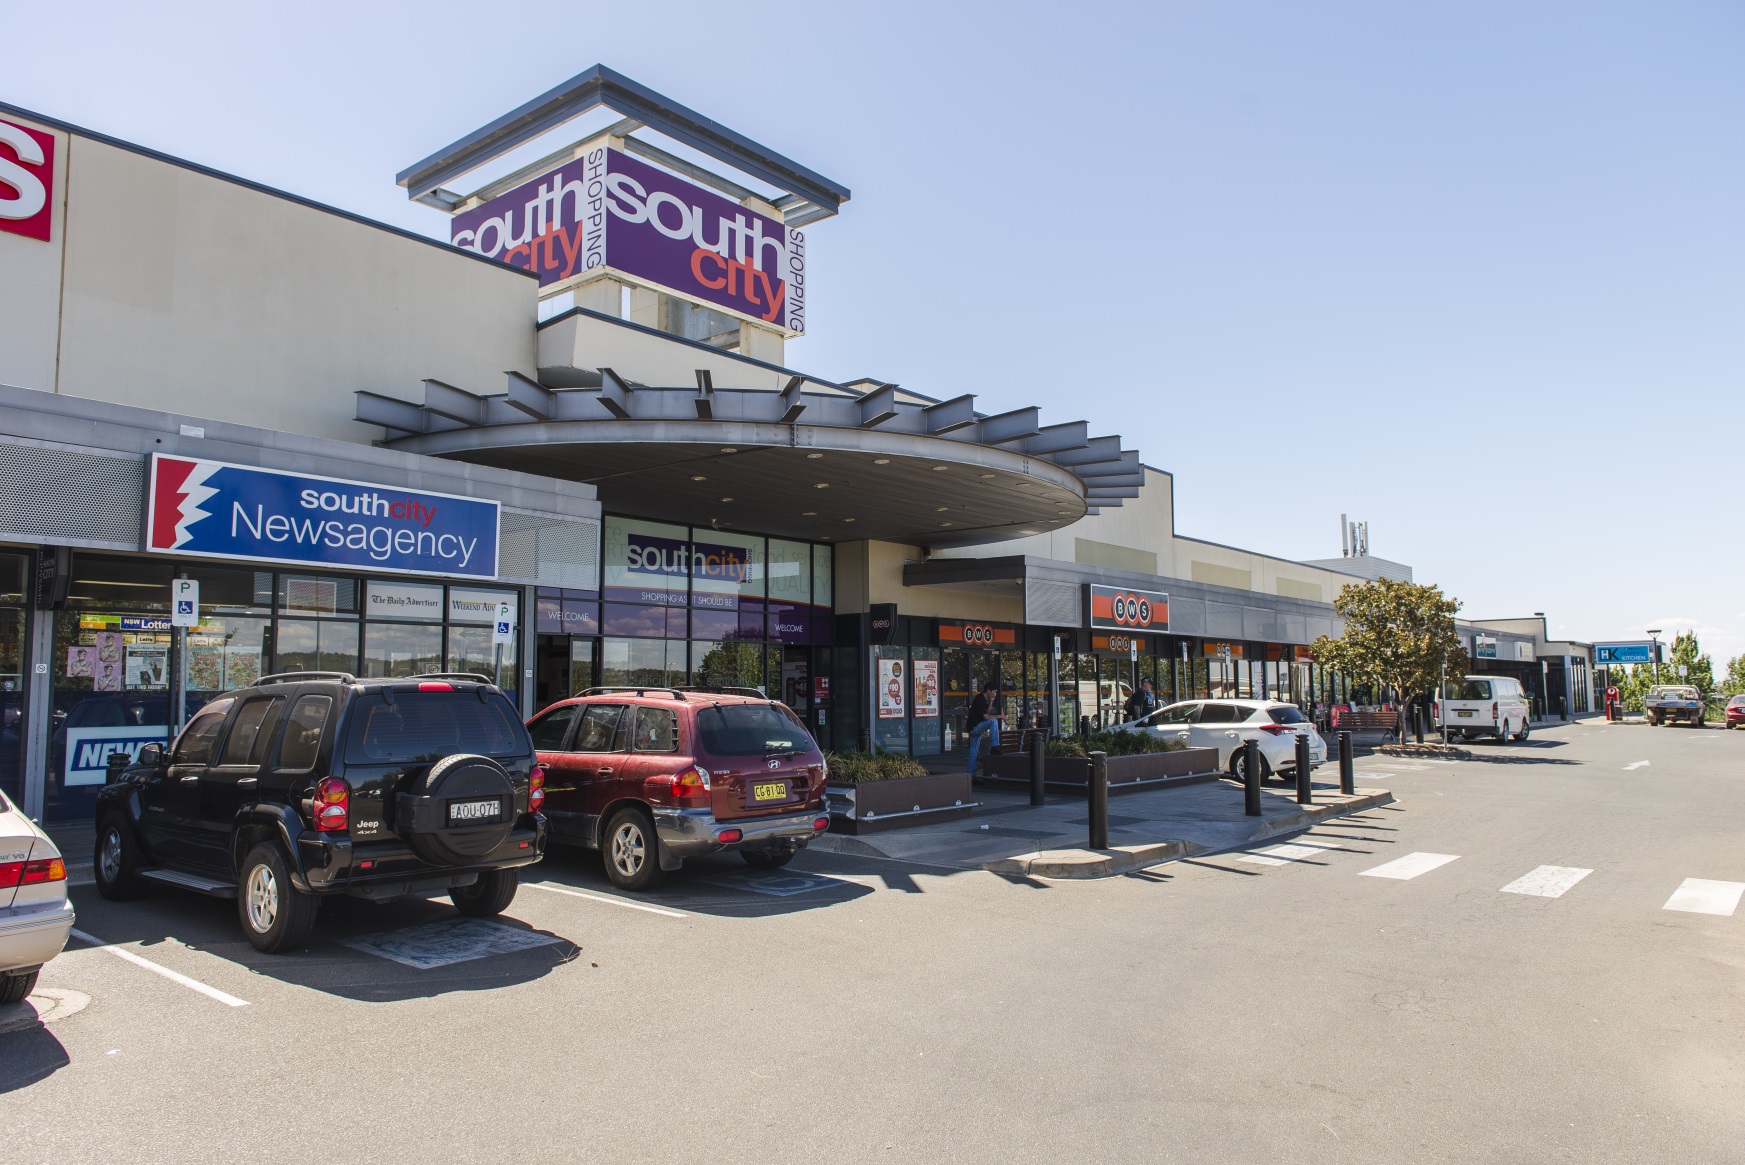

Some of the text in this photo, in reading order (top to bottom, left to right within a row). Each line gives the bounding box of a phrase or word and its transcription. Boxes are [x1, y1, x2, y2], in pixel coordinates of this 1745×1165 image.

[586, 148, 603, 269] SHOPPING
[606, 172, 785, 281] south
[503, 221, 582, 280] city
[691, 248, 785, 322] city
[789, 228, 804, 332] SHOPPING
[300, 489, 436, 527] southcity
[231, 501, 477, 567] Newsagency
[628, 544, 748, 584] southcity
[791, 551, 831, 568] serice
[180, 582, 191, 594] P
[371, 594, 439, 607] The Daily Advertiser
[452, 600, 480, 612] WEEKEND
[641, 592, 676, 603] SHOPPING
[678, 595, 688, 604] AS
[698, 597, 723, 606] SHOULD
[724, 598, 733, 607] BE
[501, 606, 509, 616] P
[548, 611, 589, 622] WELCOME
[141, 619, 171, 629] Lotter
[775, 623, 804, 633] WELCOME
[356, 820, 379, 828] Jeep
